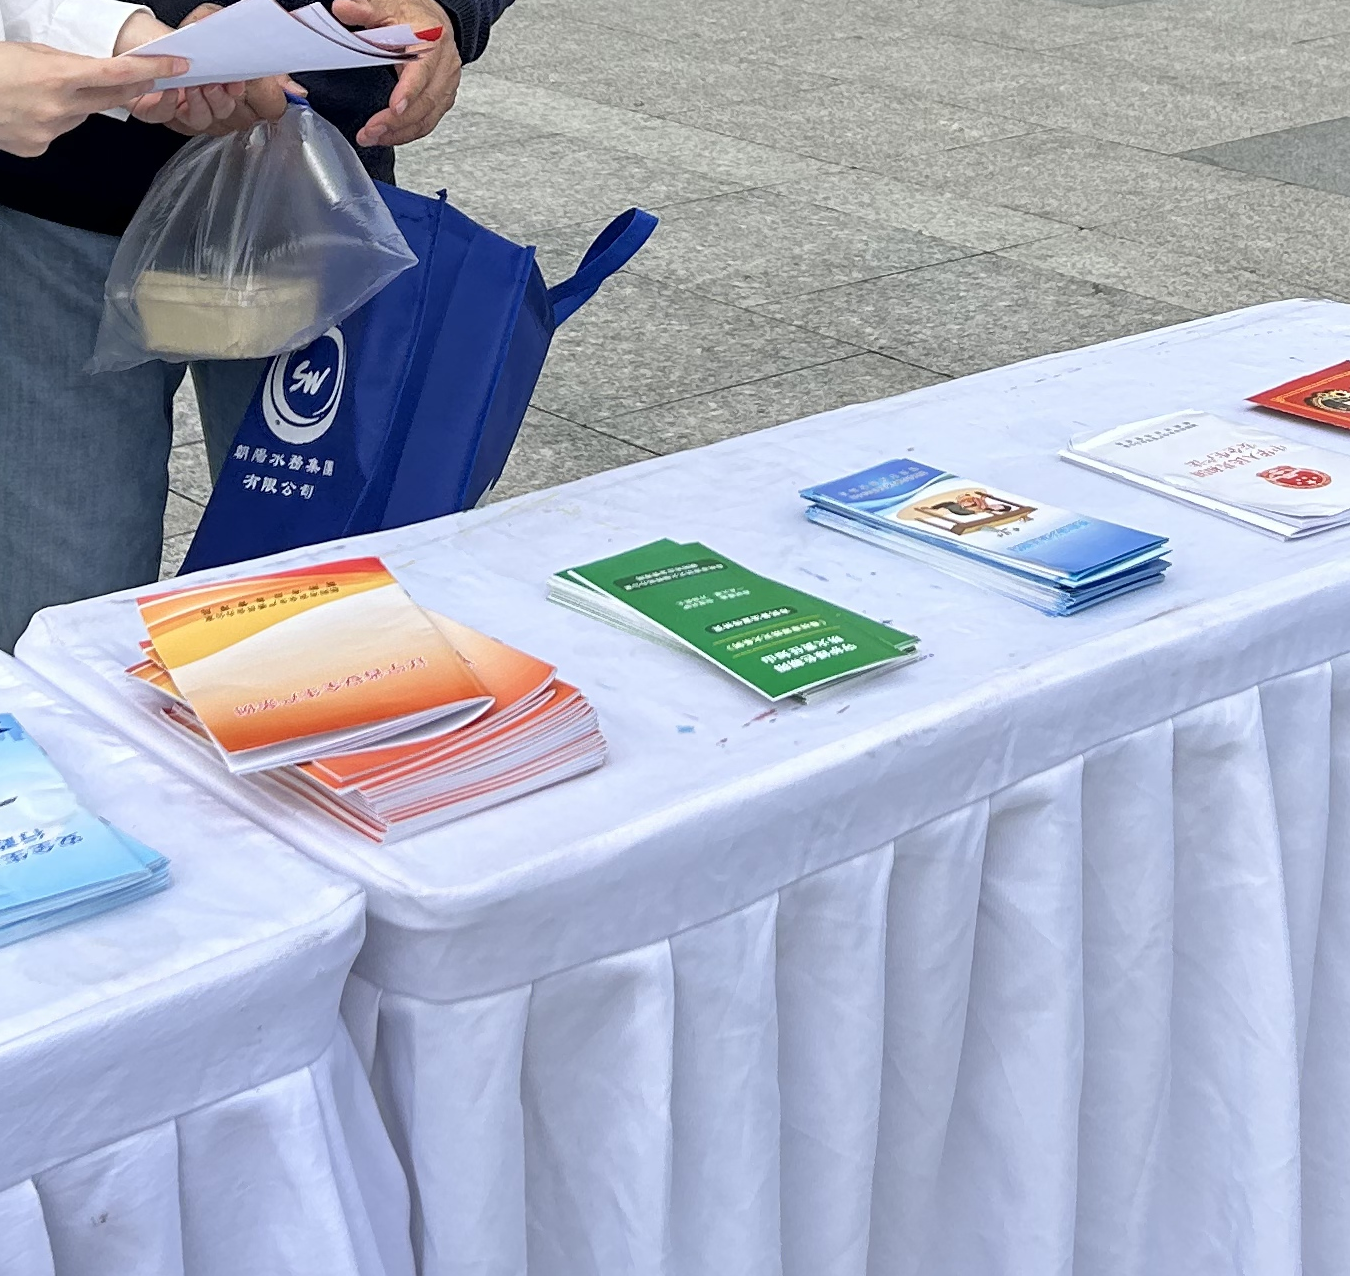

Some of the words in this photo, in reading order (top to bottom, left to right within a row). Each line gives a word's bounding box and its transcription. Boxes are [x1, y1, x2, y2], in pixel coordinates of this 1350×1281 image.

[290, 360, 332, 397] SW
[243, 473, 315, 502] 有限公司
